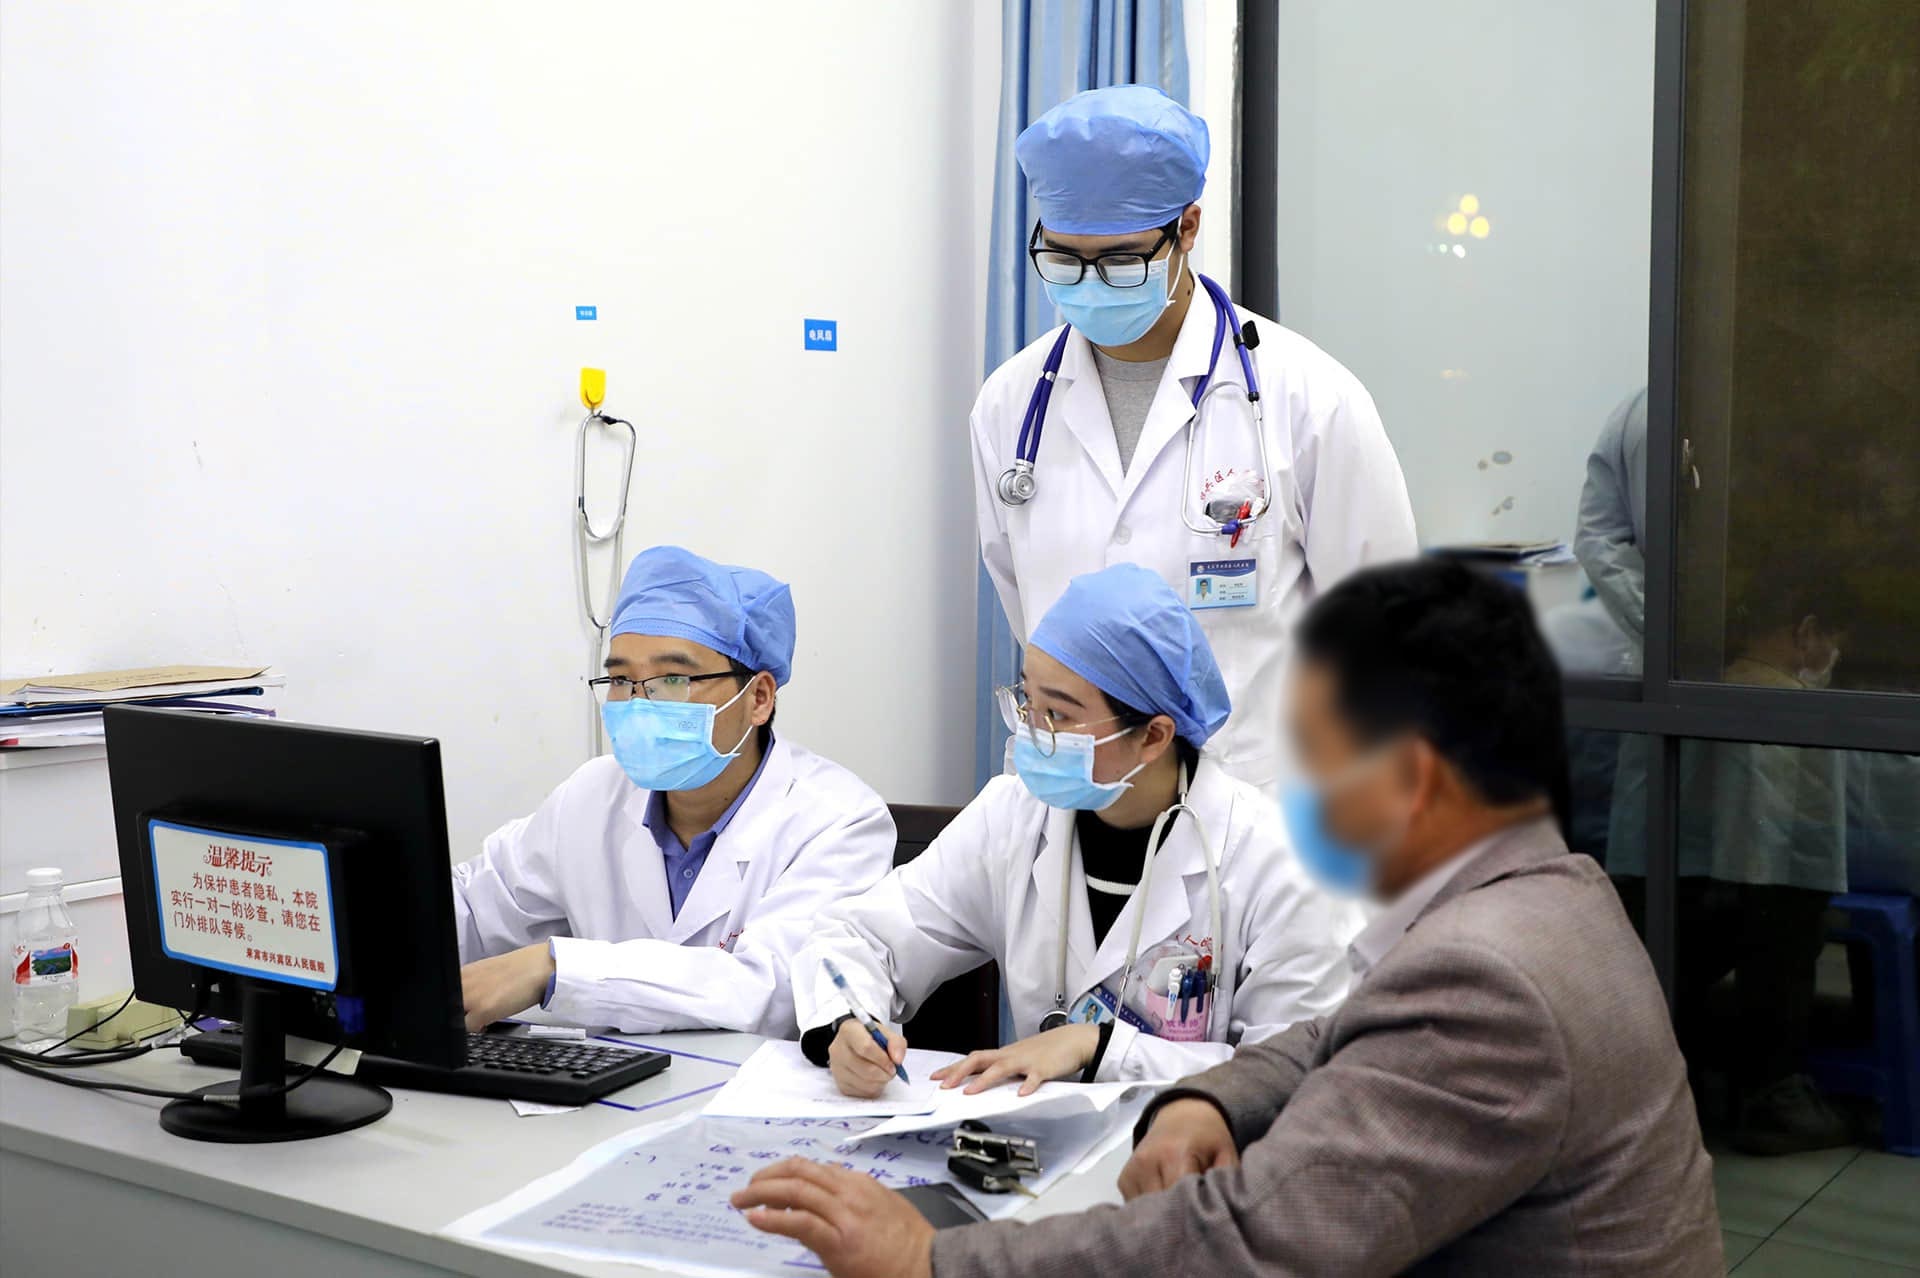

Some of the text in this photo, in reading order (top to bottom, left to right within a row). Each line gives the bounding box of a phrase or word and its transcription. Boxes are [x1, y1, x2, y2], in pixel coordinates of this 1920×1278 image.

[204, 844, 273, 877] 温馨提示
[192, 872, 319, 910] 为保护患者隐私，本院
[170, 890, 321, 932] 实行一对一的诊查，请您在
[173, 910, 253, 942] 门外排队等候。
